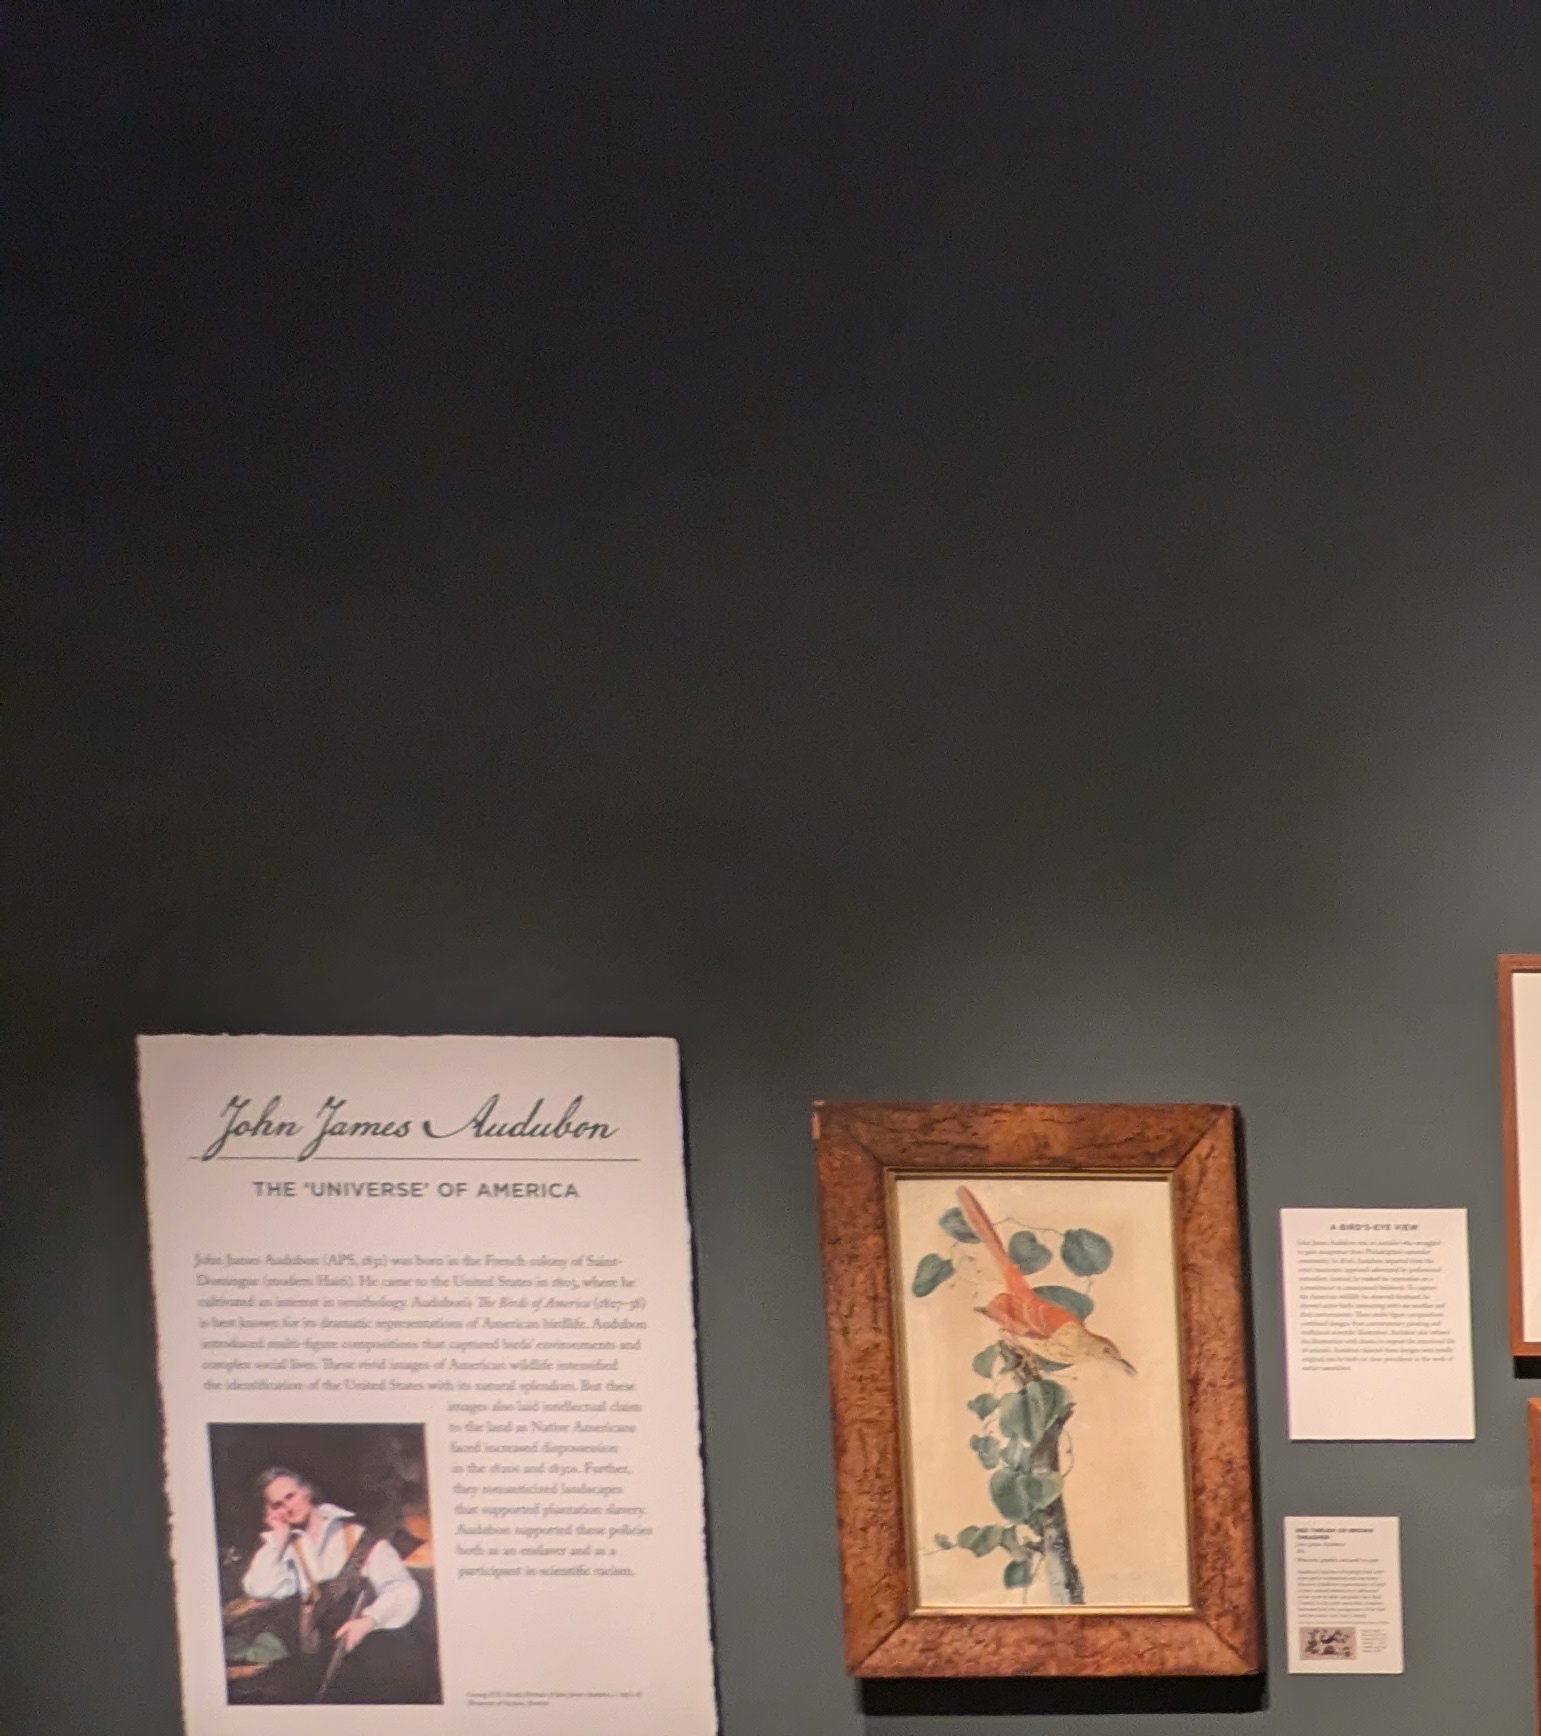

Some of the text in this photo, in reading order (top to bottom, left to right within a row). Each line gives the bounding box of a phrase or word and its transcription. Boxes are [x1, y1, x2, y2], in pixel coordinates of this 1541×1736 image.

[201, 1094, 619, 1161] John James Audubon
[252, 1181, 296, 1198] THE
[437, 1181, 470, 1198] OF
[477, 1181, 579, 1198] AMERICA
[1394, 1223, 1419, 1231] VIEW
